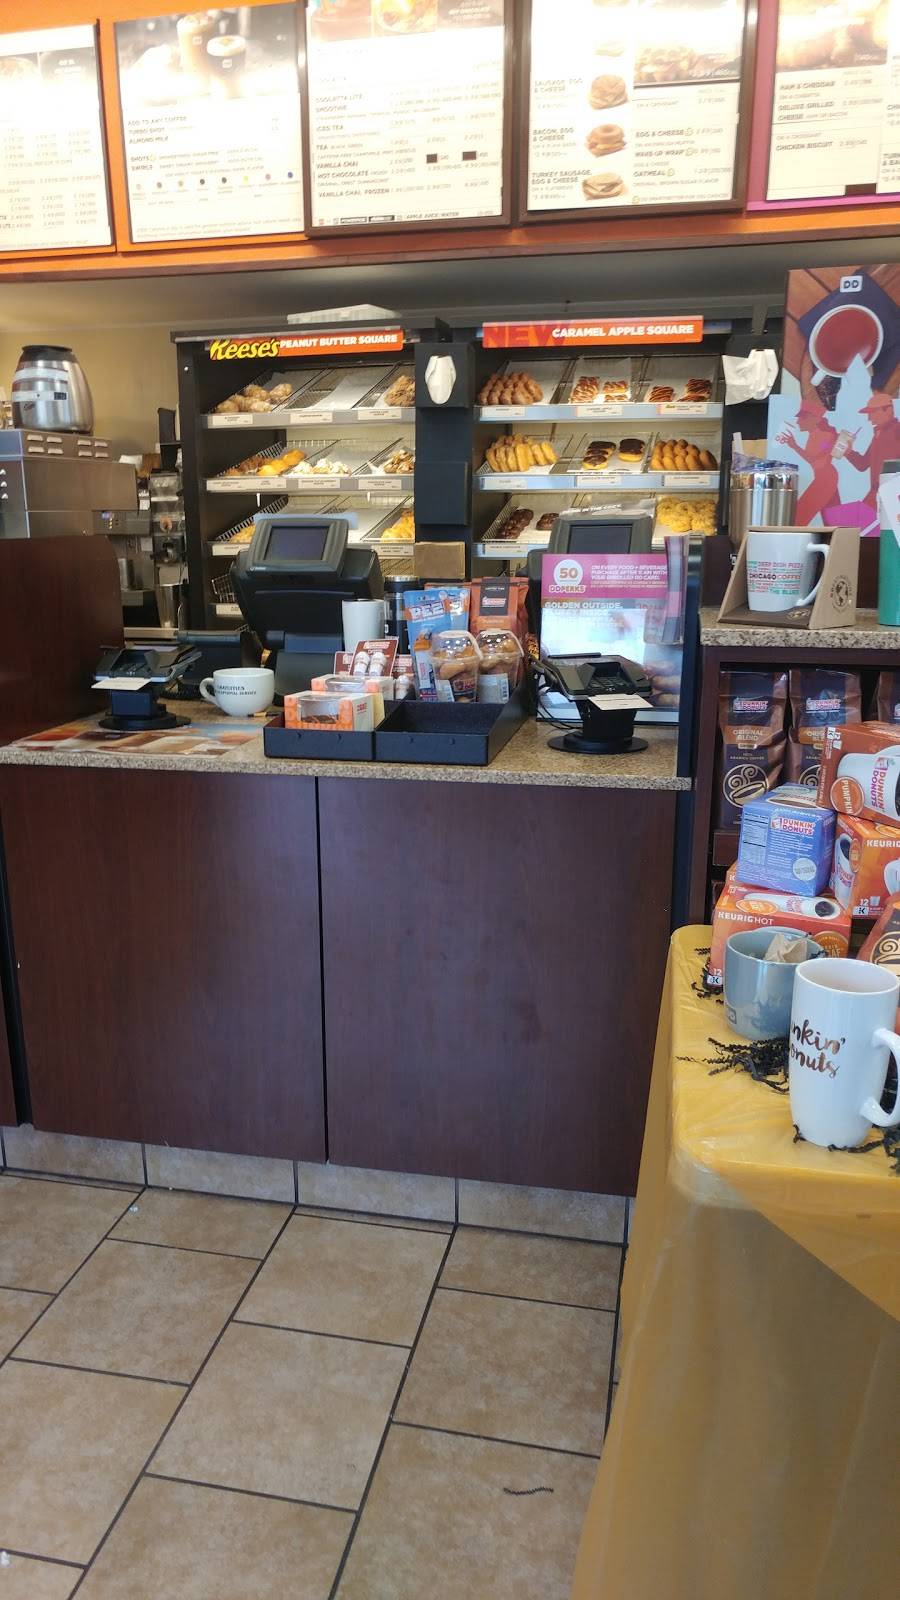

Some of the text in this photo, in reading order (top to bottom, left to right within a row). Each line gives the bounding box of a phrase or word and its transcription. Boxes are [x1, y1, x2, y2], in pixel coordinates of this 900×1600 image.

[843, 279, 859, 289] DD
[484, 323, 694, 348] NEW CARAMEL APPLE SQUARE
[280, 337, 318, 349] PEANUT
[319, 336, 357, 347] BUTTER
[358, 334, 398, 345] SQUARE
[559, 567, 578, 579] 50
[544, 601, 580, 609] GOLDEN
[870, 770, 880, 808] DONUTS
[841, 779, 854, 814] PUMPKIN
[782, 818, 816, 829] DUNKIN'
[782, 824, 814, 835] DONUTS
[860, 898, 869, 906] 12
[713, 968, 722, 976] 12
